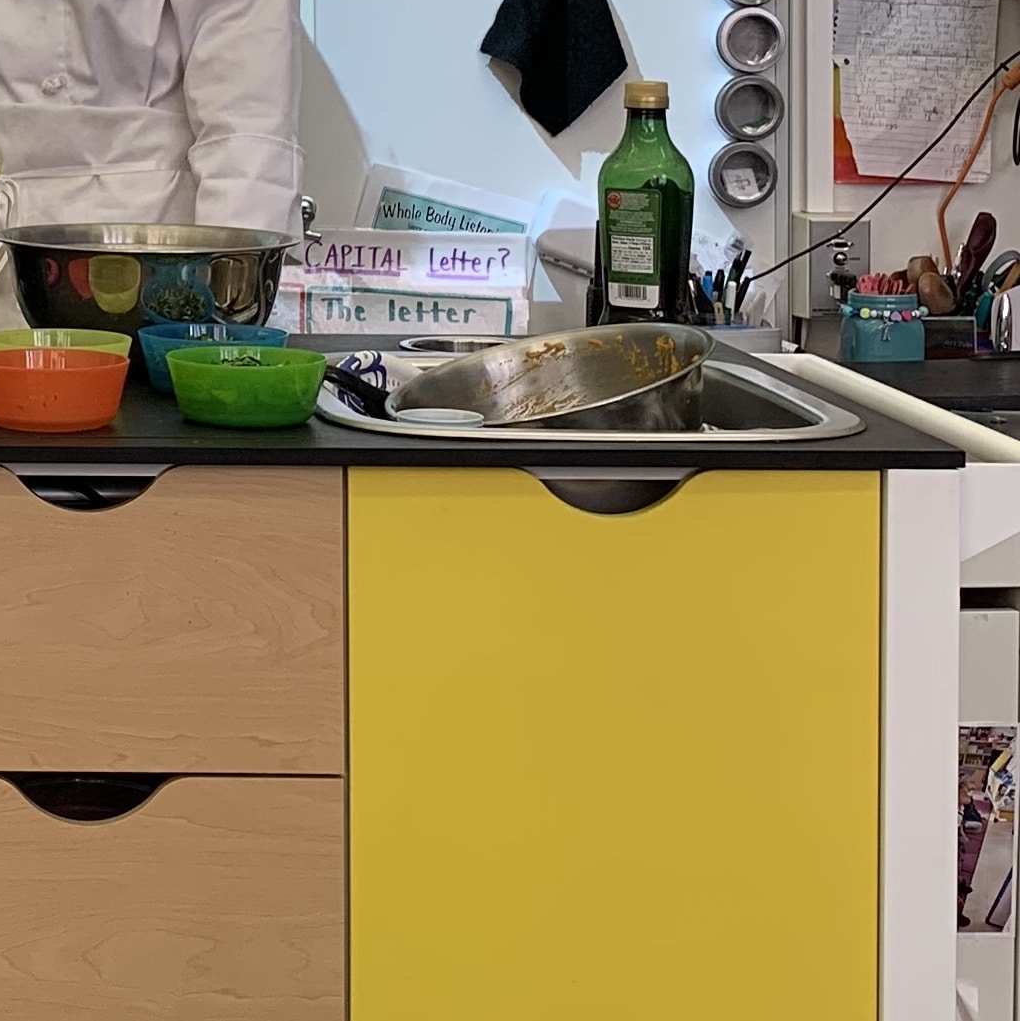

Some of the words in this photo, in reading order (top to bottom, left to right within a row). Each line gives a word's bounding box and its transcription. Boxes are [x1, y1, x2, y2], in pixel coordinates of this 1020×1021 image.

[383, 202, 422, 220] Whole
[426, 206, 456, 231] Body
[305, 242, 408, 271] CAPITAL
[321, 297, 367, 322] The
[389, 299, 477, 324] letter
